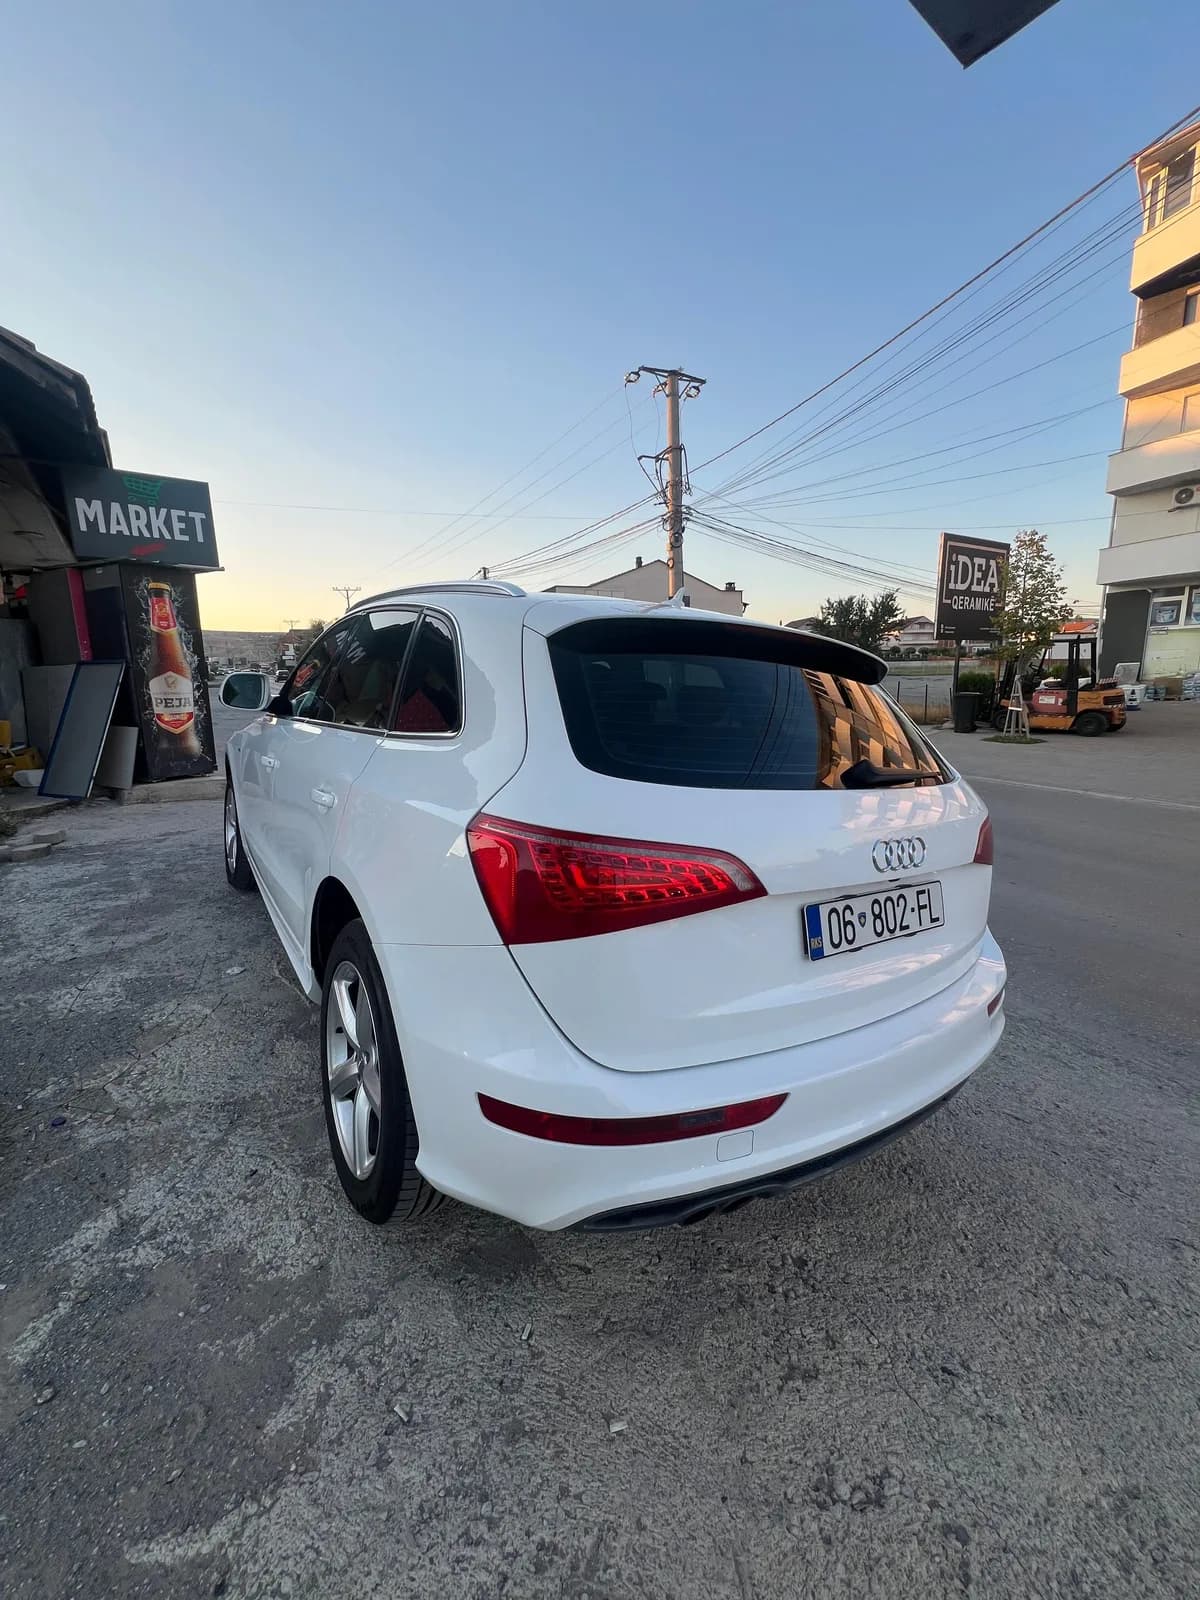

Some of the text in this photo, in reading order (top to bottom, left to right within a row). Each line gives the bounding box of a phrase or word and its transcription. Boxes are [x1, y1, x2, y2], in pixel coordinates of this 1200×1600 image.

[75, 497, 206, 543] MARKET
[155, 697, 191, 709] PEJA
[827, 904, 857, 950] 06
